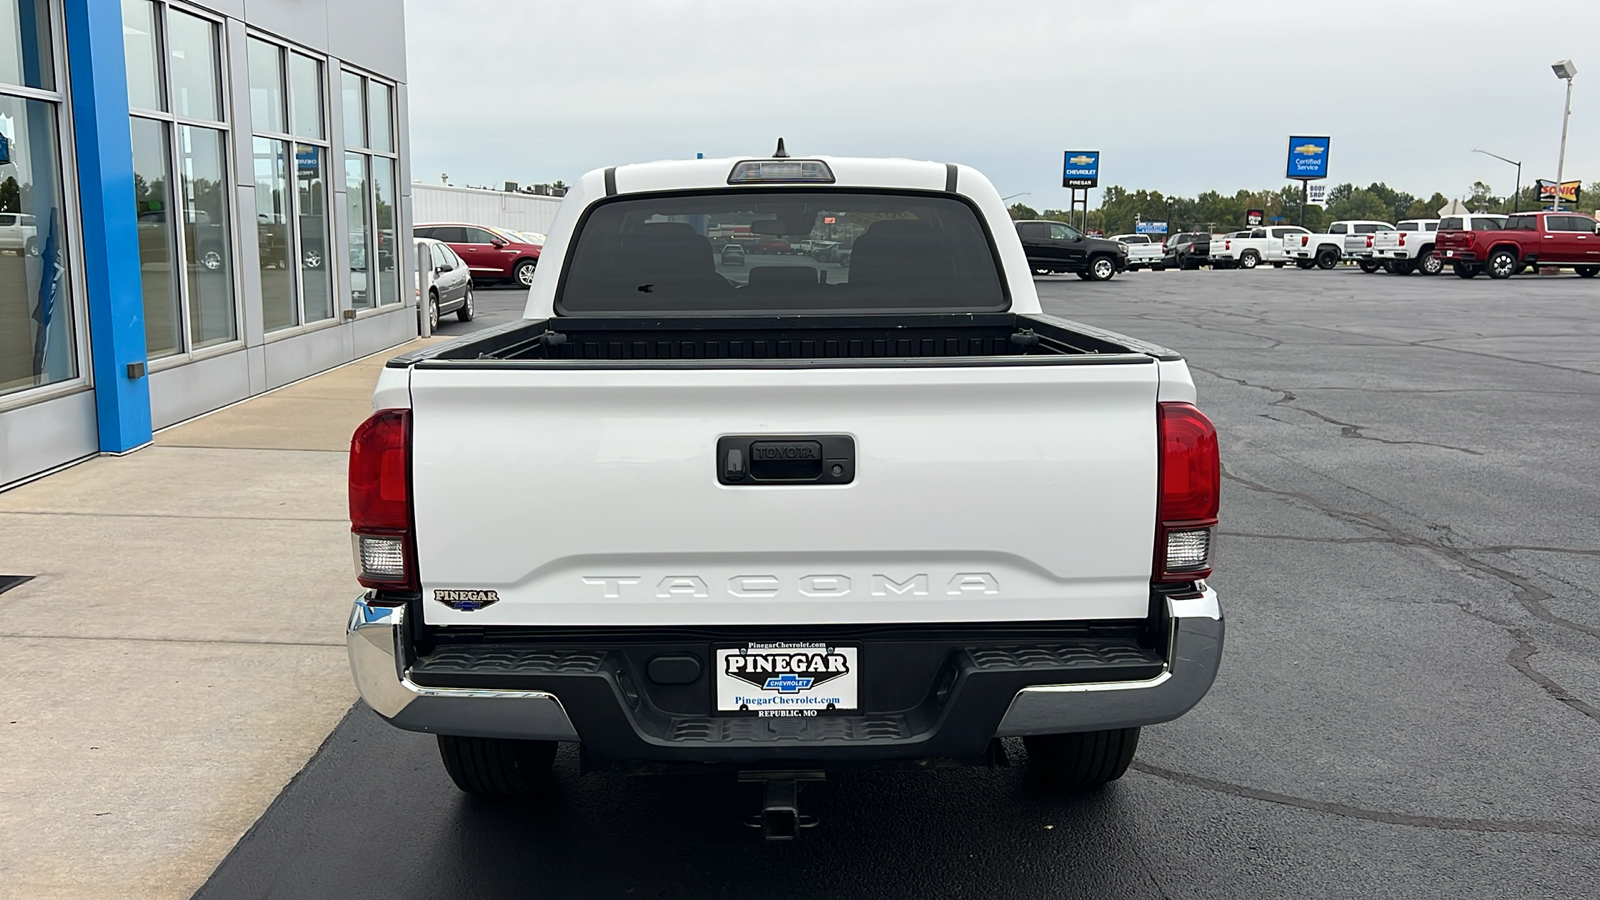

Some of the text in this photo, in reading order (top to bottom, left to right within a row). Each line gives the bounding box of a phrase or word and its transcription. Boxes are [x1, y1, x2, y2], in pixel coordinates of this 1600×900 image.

[1542, 186, 1576, 195] SONIC
[756, 446, 817, 459] TOYOTA
[581, 572, 1000, 599] TACOMA
[435, 590, 499, 601] PINEGAR
[727, 655, 847, 673] PINEGAR
[735, 696, 840, 706] PinegarChevrolet.com
